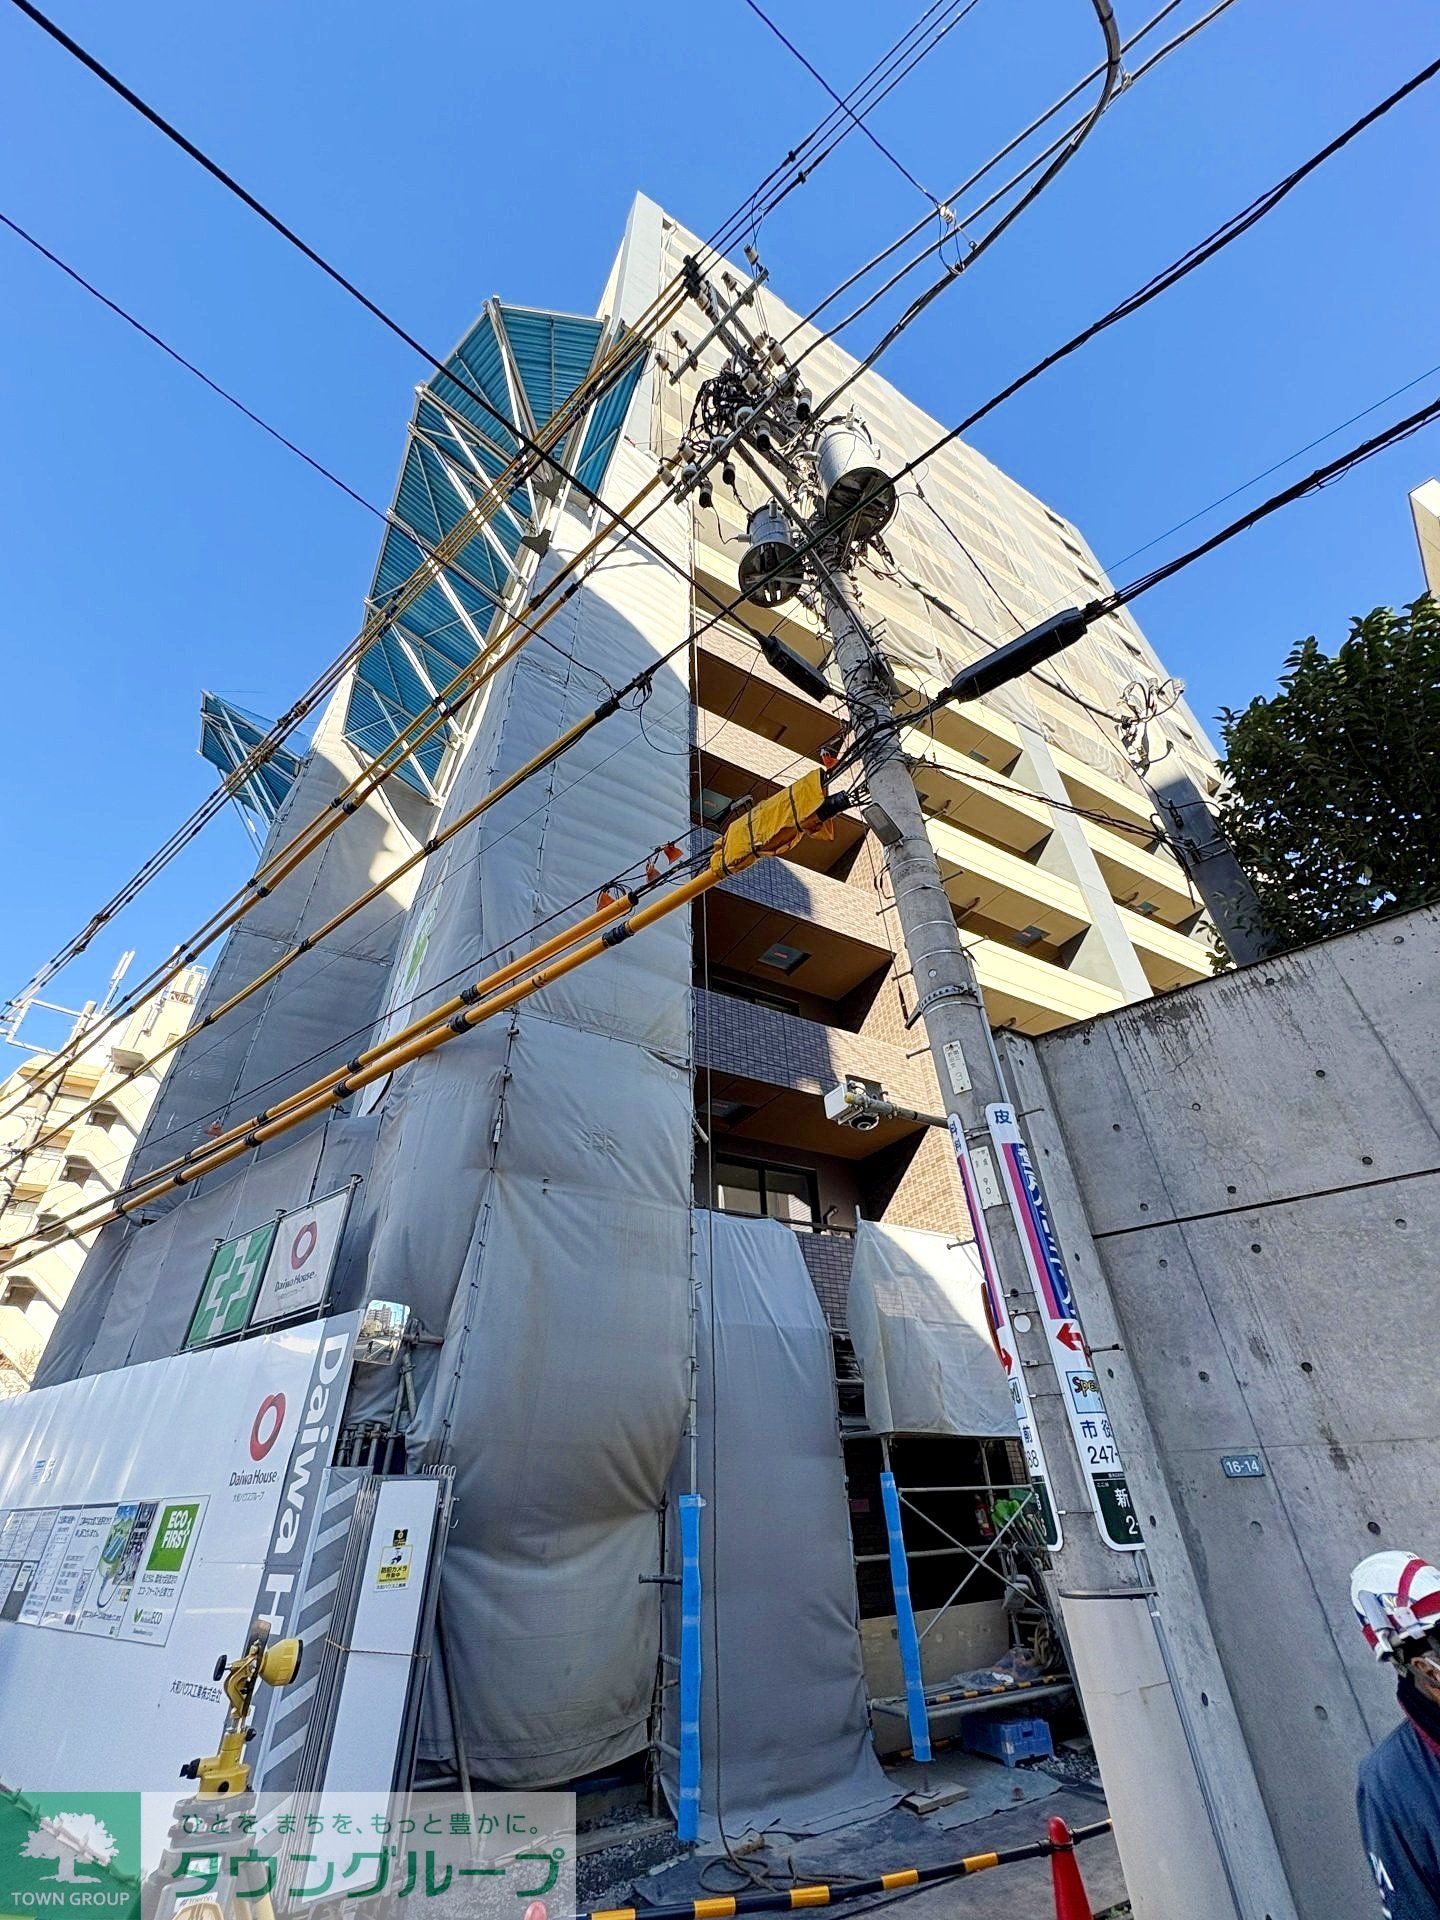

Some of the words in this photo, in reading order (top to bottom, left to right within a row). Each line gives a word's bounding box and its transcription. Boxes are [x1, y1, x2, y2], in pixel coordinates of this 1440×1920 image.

[275, 1333, 350, 1554] Daiwa
[1226, 1460, 1259, 1473] 16-14
[229, 1469, 253, 1487] Daiwa
[253, 1468, 278, 1485] House
[167, 1510, 189, 1529] ECO
[161, 1530, 189, 1549] FIRST
